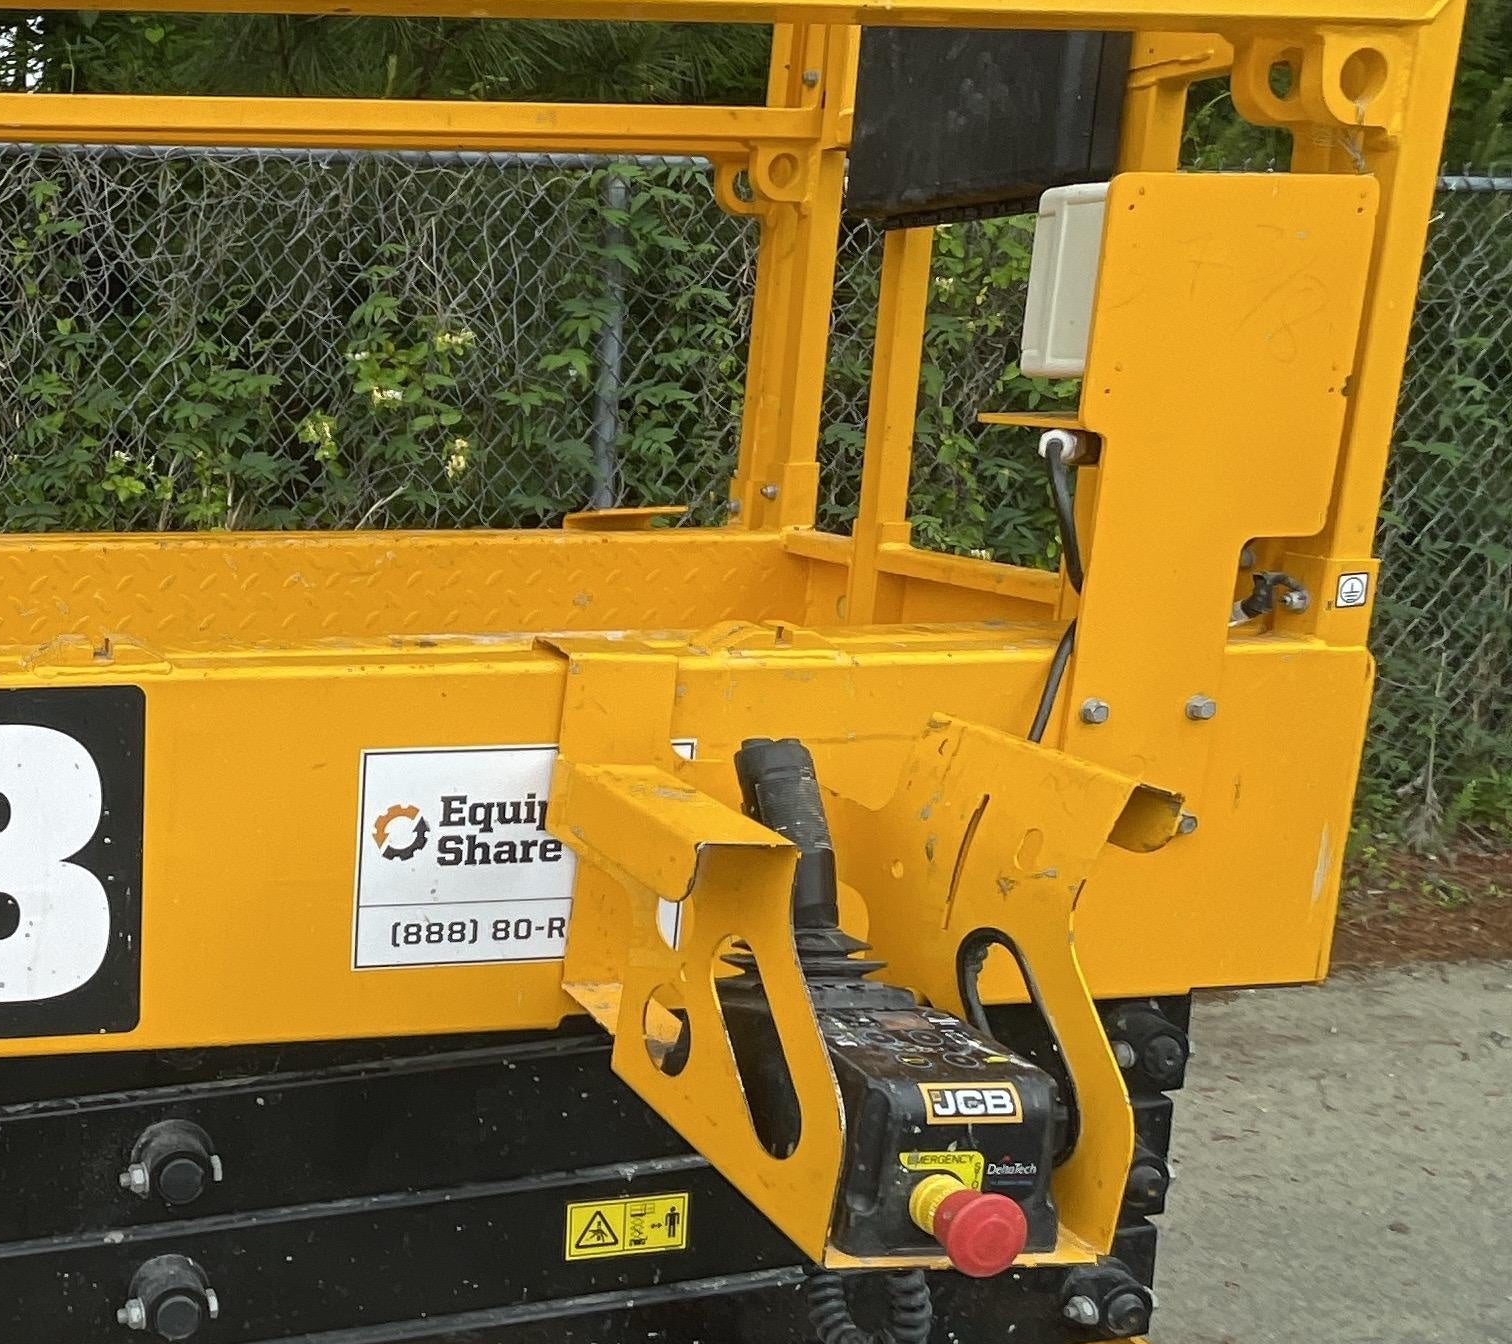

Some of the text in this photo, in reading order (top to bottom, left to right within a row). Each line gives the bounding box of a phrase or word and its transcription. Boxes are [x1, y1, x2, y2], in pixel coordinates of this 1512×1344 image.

[437, 834, 563, 867] Share
[391, 916, 566, 947] (888) 80-R
[933, 1089, 1014, 1115] JCB
[987, 1162, 1037, 1175] DeltaTech
